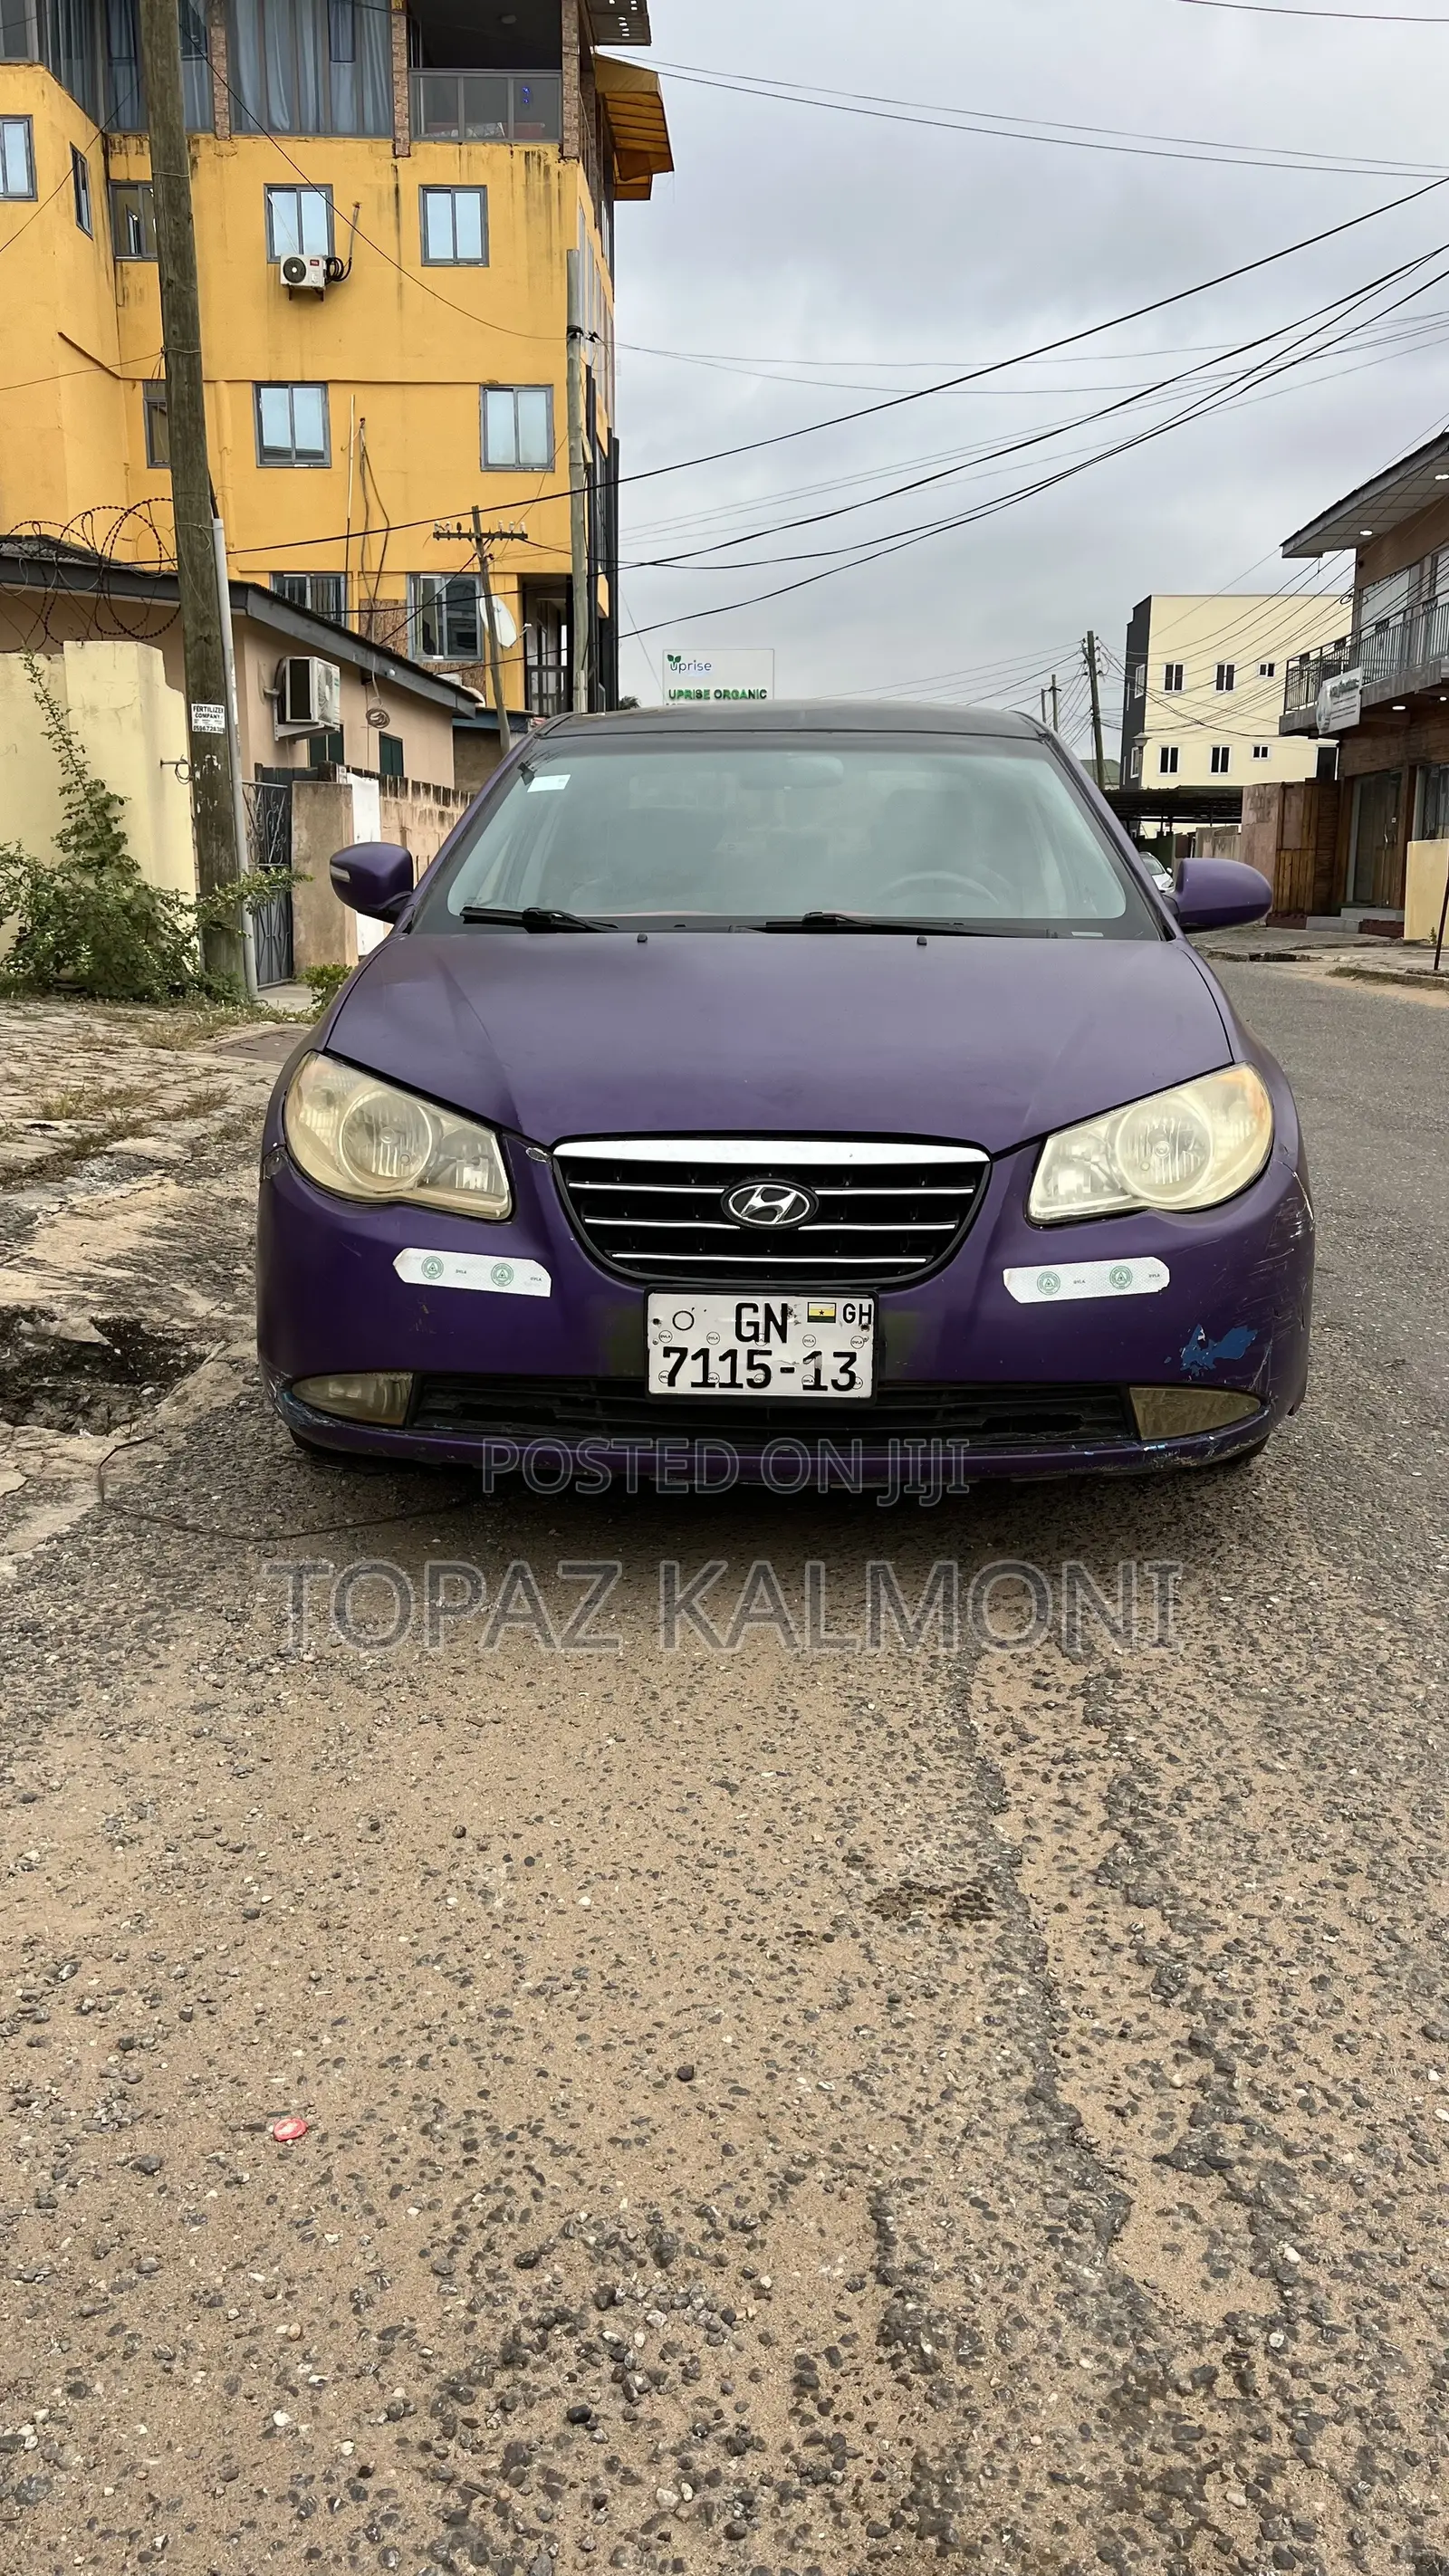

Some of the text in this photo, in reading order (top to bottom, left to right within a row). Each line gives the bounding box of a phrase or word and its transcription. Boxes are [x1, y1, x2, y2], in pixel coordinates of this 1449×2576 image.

[670, 659, 712, 674] uprise
[668, 689, 767, 700] UPRISE ORGANIC
[734, 1302, 789, 1344] GN
[842, 1303, 872, 1325] GH
[663, 1346, 858, 1392] 7115-13
